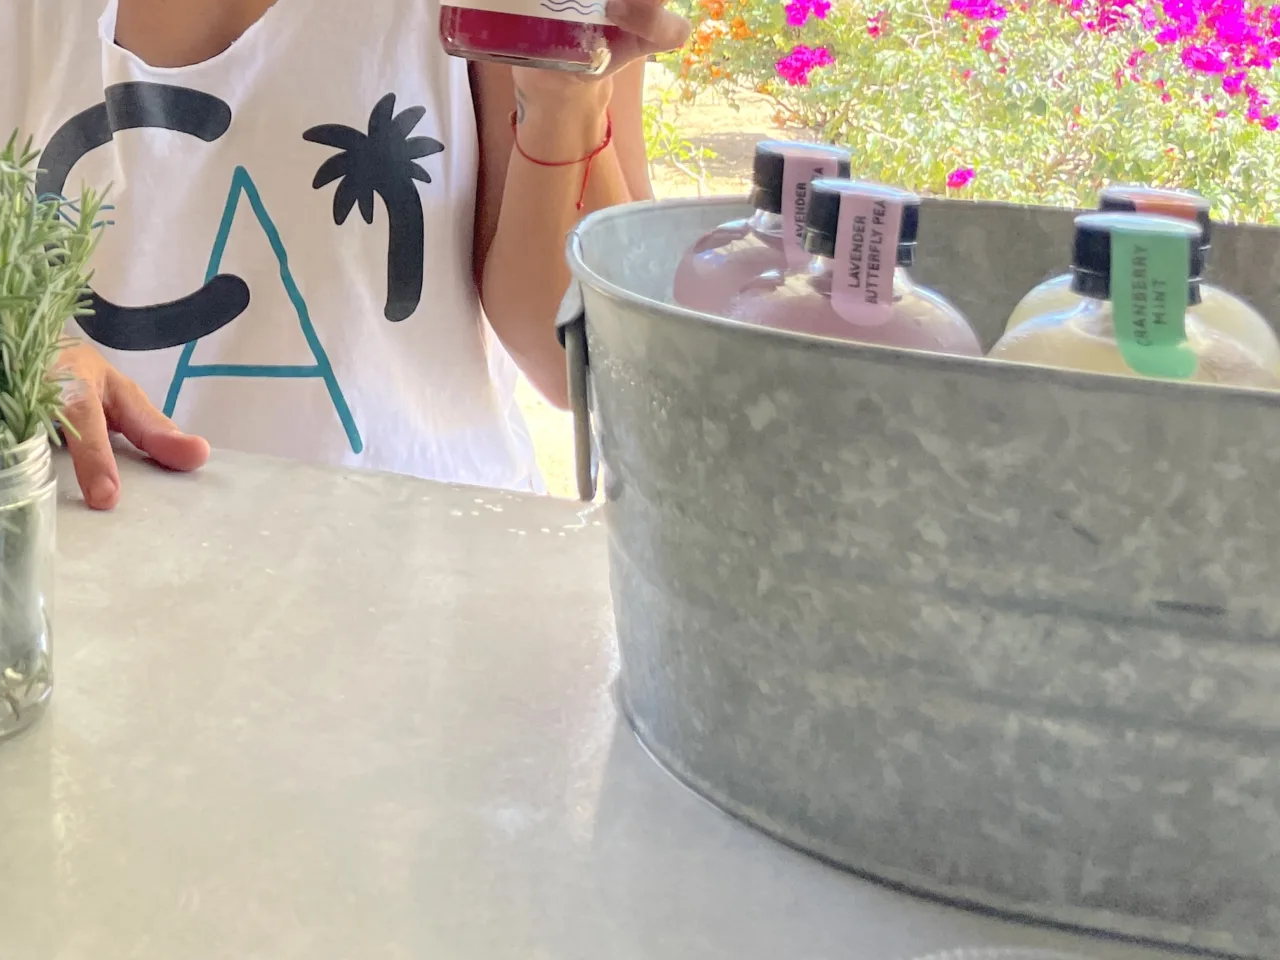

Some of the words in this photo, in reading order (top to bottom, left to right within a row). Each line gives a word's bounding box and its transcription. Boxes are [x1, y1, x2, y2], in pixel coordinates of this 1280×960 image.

[871, 200, 886, 225] PEA
[848, 215, 866, 289] LAVENDER
[865, 228, 883, 305] BUTTERFLY
[1132, 245, 1152, 347] CRANBERRY
[1152, 279, 1167, 326] MINT
